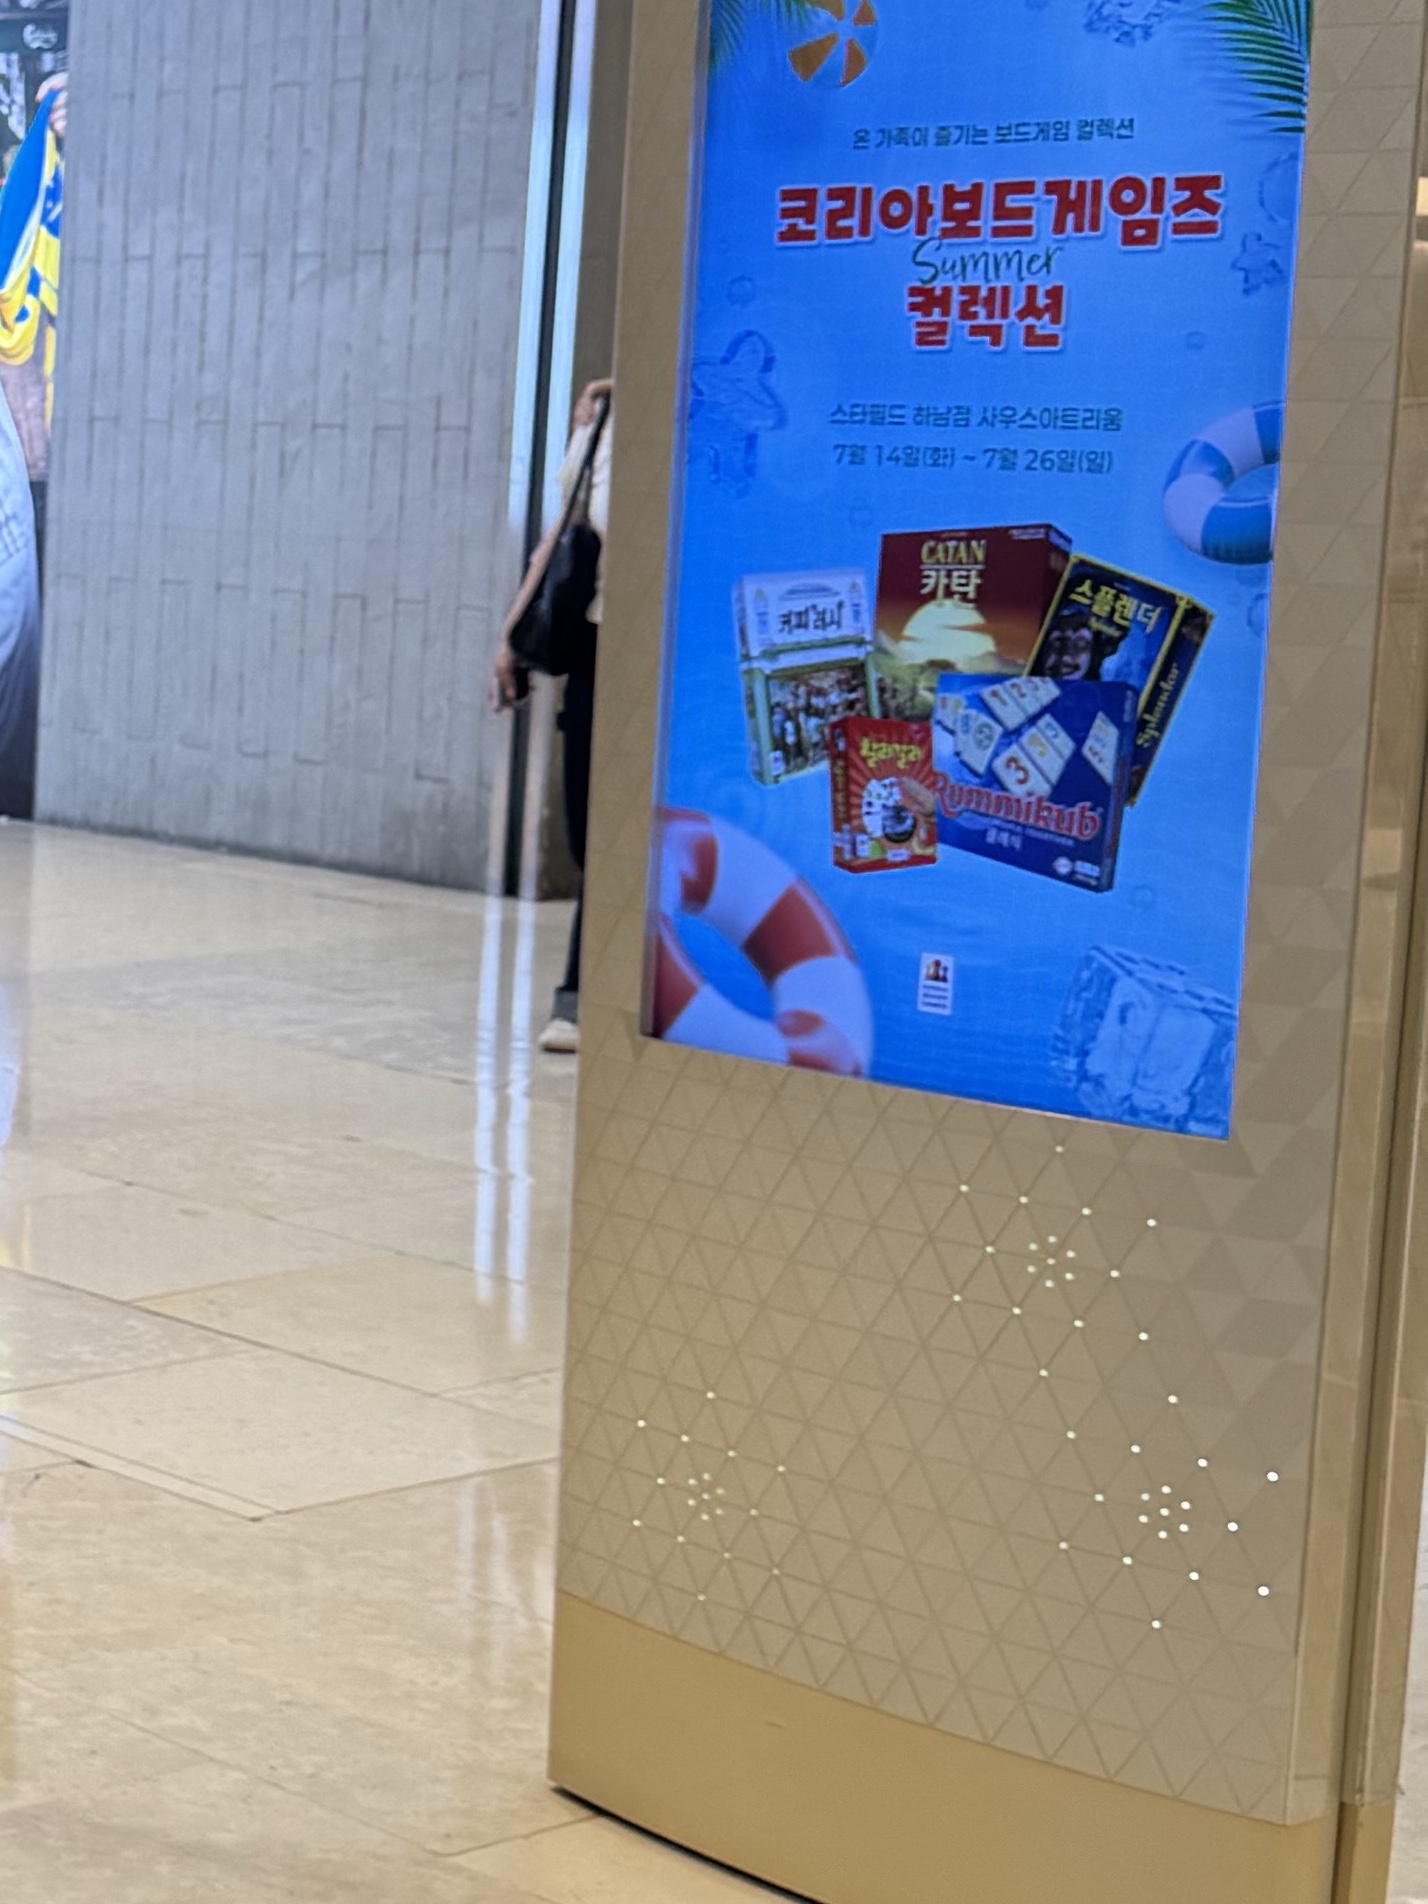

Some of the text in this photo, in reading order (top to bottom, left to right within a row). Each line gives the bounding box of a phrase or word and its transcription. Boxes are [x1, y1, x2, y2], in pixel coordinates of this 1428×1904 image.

[875, 126, 929, 149] 가족이
[994, 120, 1070, 144] 보드게임
[1076, 117, 1135, 141] 컬렉션
[775, 173, 1224, 248] 코리아보드게임즈
[911, 236, 1064, 285] Summer
[906, 284, 1066, 349] 컬렉션
[829, 402, 1124, 432] 스타필드 하남점 사우스아트리움
[833, 443, 866, 466] 7월
[983, 447, 1019, 472] 7월
[1025, 448, 1114, 475] 26일(일)
[920, 539, 988, 564] CATAN
[920, 569, 984, 609] 카탄
[1069, 578, 1163, 635] 스플렌더
[934, 769, 1101, 841] Rummikub
